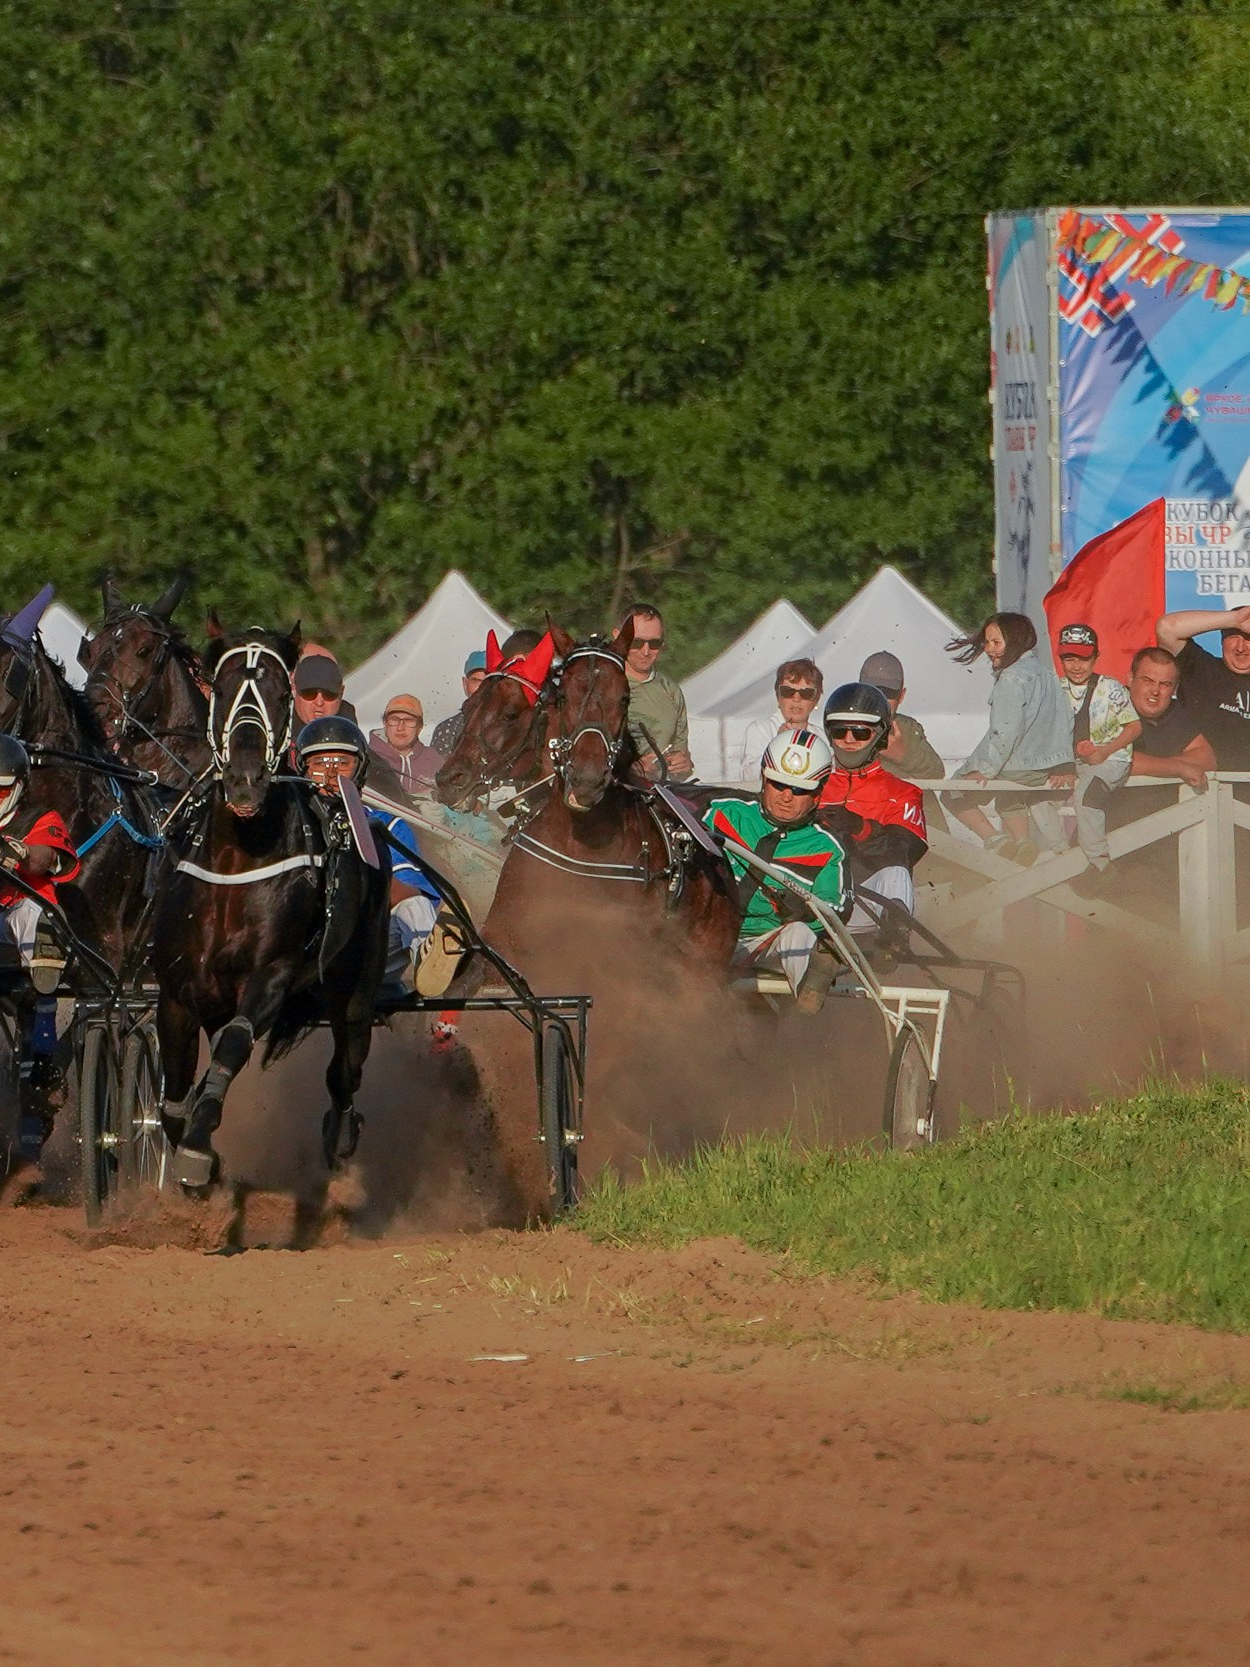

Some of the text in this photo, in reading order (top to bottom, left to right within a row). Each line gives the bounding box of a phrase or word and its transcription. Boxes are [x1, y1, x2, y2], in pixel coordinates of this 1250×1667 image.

[1167, 502, 1239, 521] КУБОК
[1202, 525, 1231, 545] ЧР
[1200, 574, 1250, 594] БЕГА
